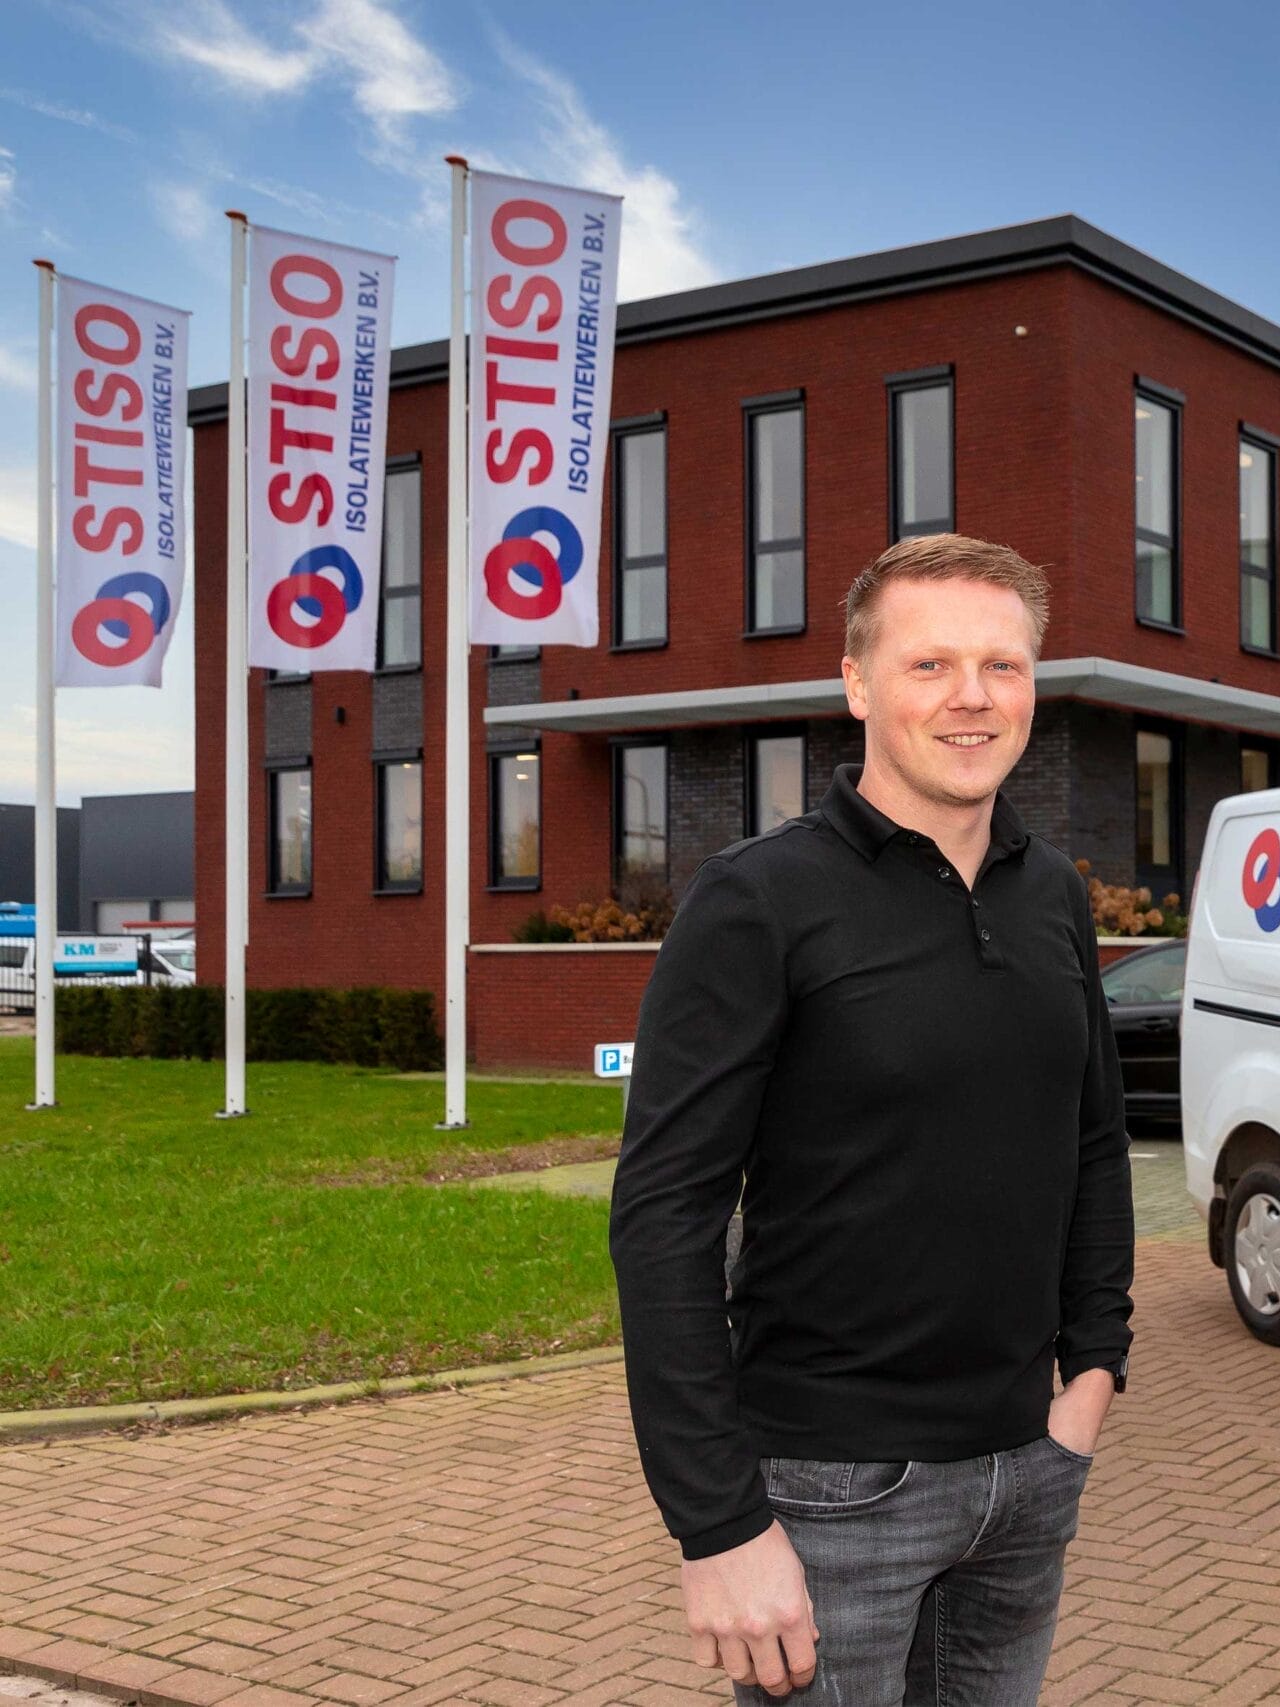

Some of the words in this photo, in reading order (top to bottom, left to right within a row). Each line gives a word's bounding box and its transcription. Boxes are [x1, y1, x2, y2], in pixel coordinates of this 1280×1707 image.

[356, 271, 379, 309] B.V.
[582, 212, 605, 253] B.V.
[73, 304, 143, 556] STISO
[154, 322, 175, 360] B.V.
[267, 255, 343, 528] STISO
[345, 315, 377, 532] ISOLATIEWERKEN
[485, 199, 567, 486] STISO
[568, 260, 602, 493] ISOLATIEWERKEN
[152, 364, 174, 559] ISOLATIEWERKEN
[64, 943, 95, 956] KM
